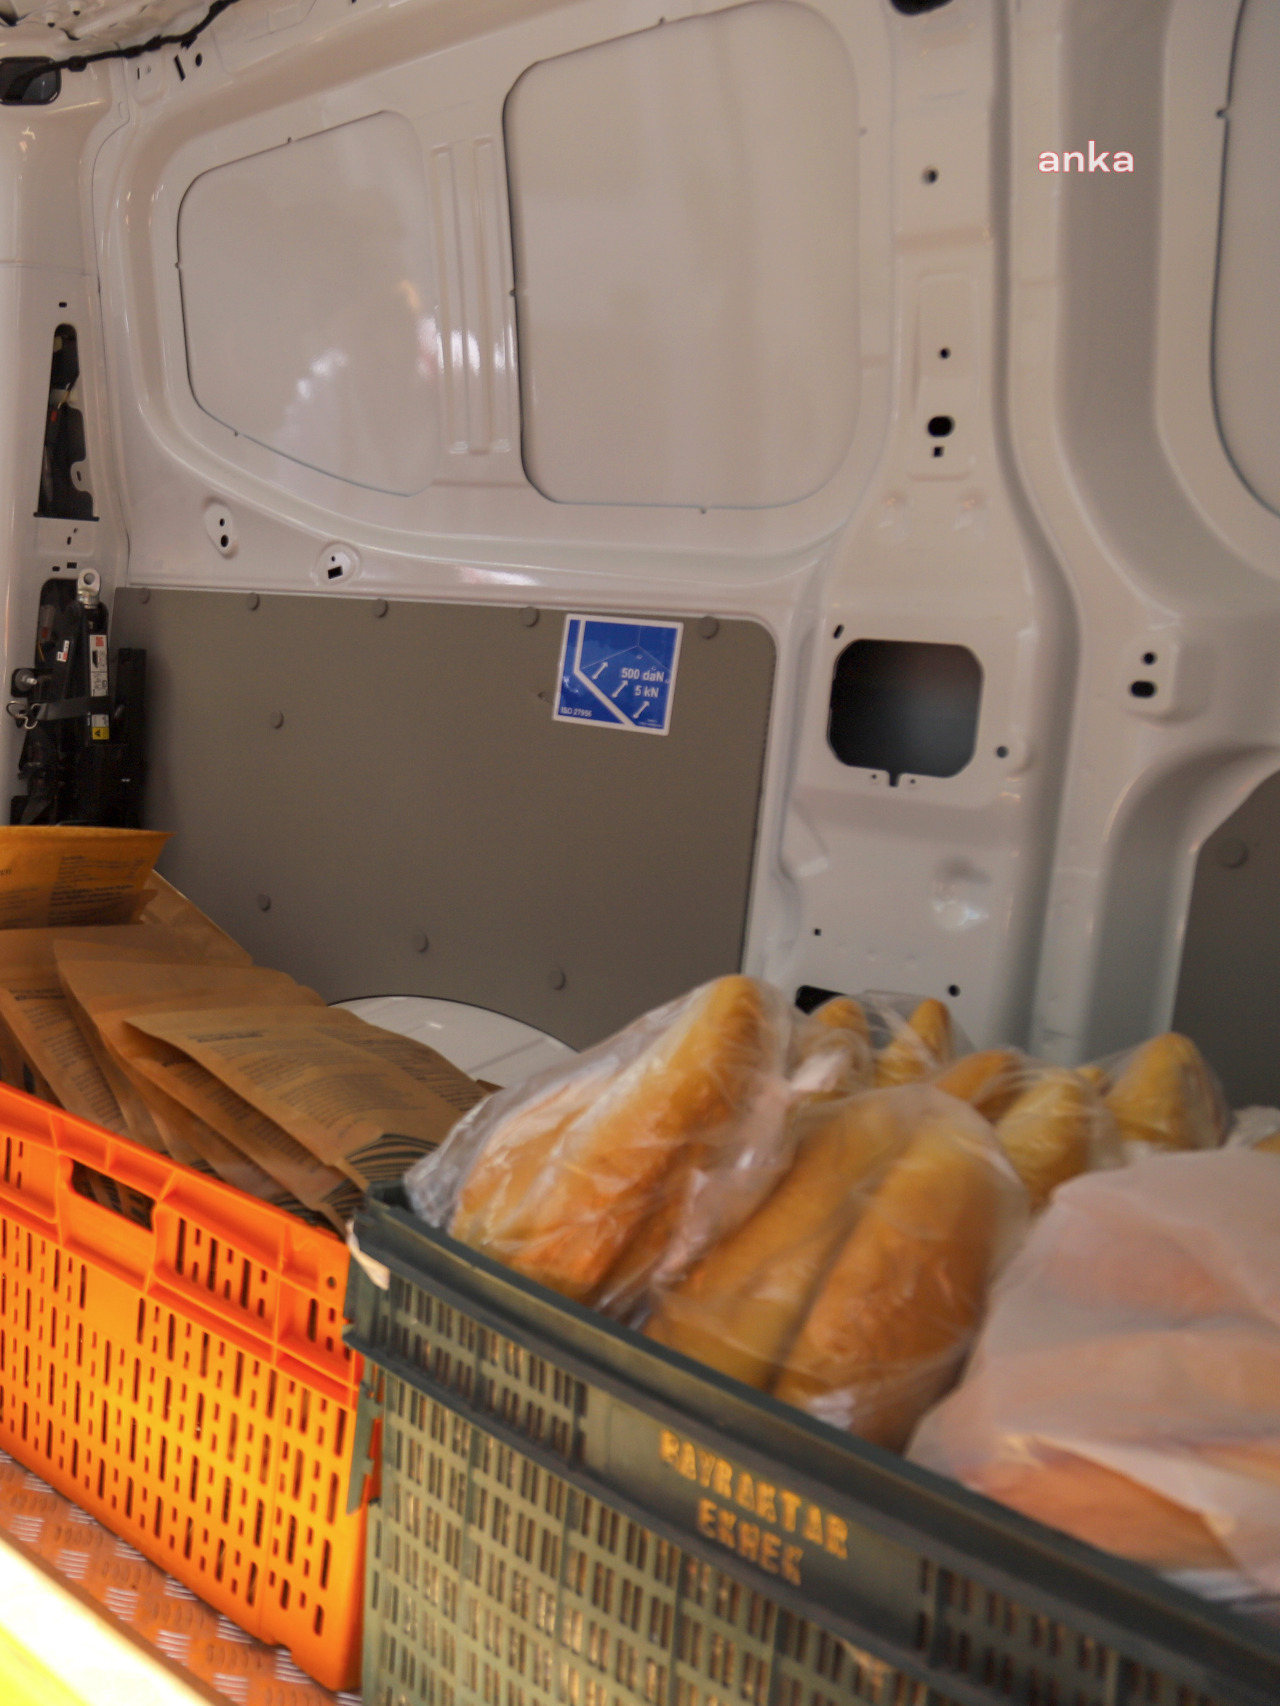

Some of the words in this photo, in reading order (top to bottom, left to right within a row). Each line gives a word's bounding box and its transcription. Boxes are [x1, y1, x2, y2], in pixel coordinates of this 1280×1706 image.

[621, 667, 640, 680] 500
[642, 670, 665, 683] daN
[634, 685, 642, 696] 5
[644, 685, 660, 698] kN
